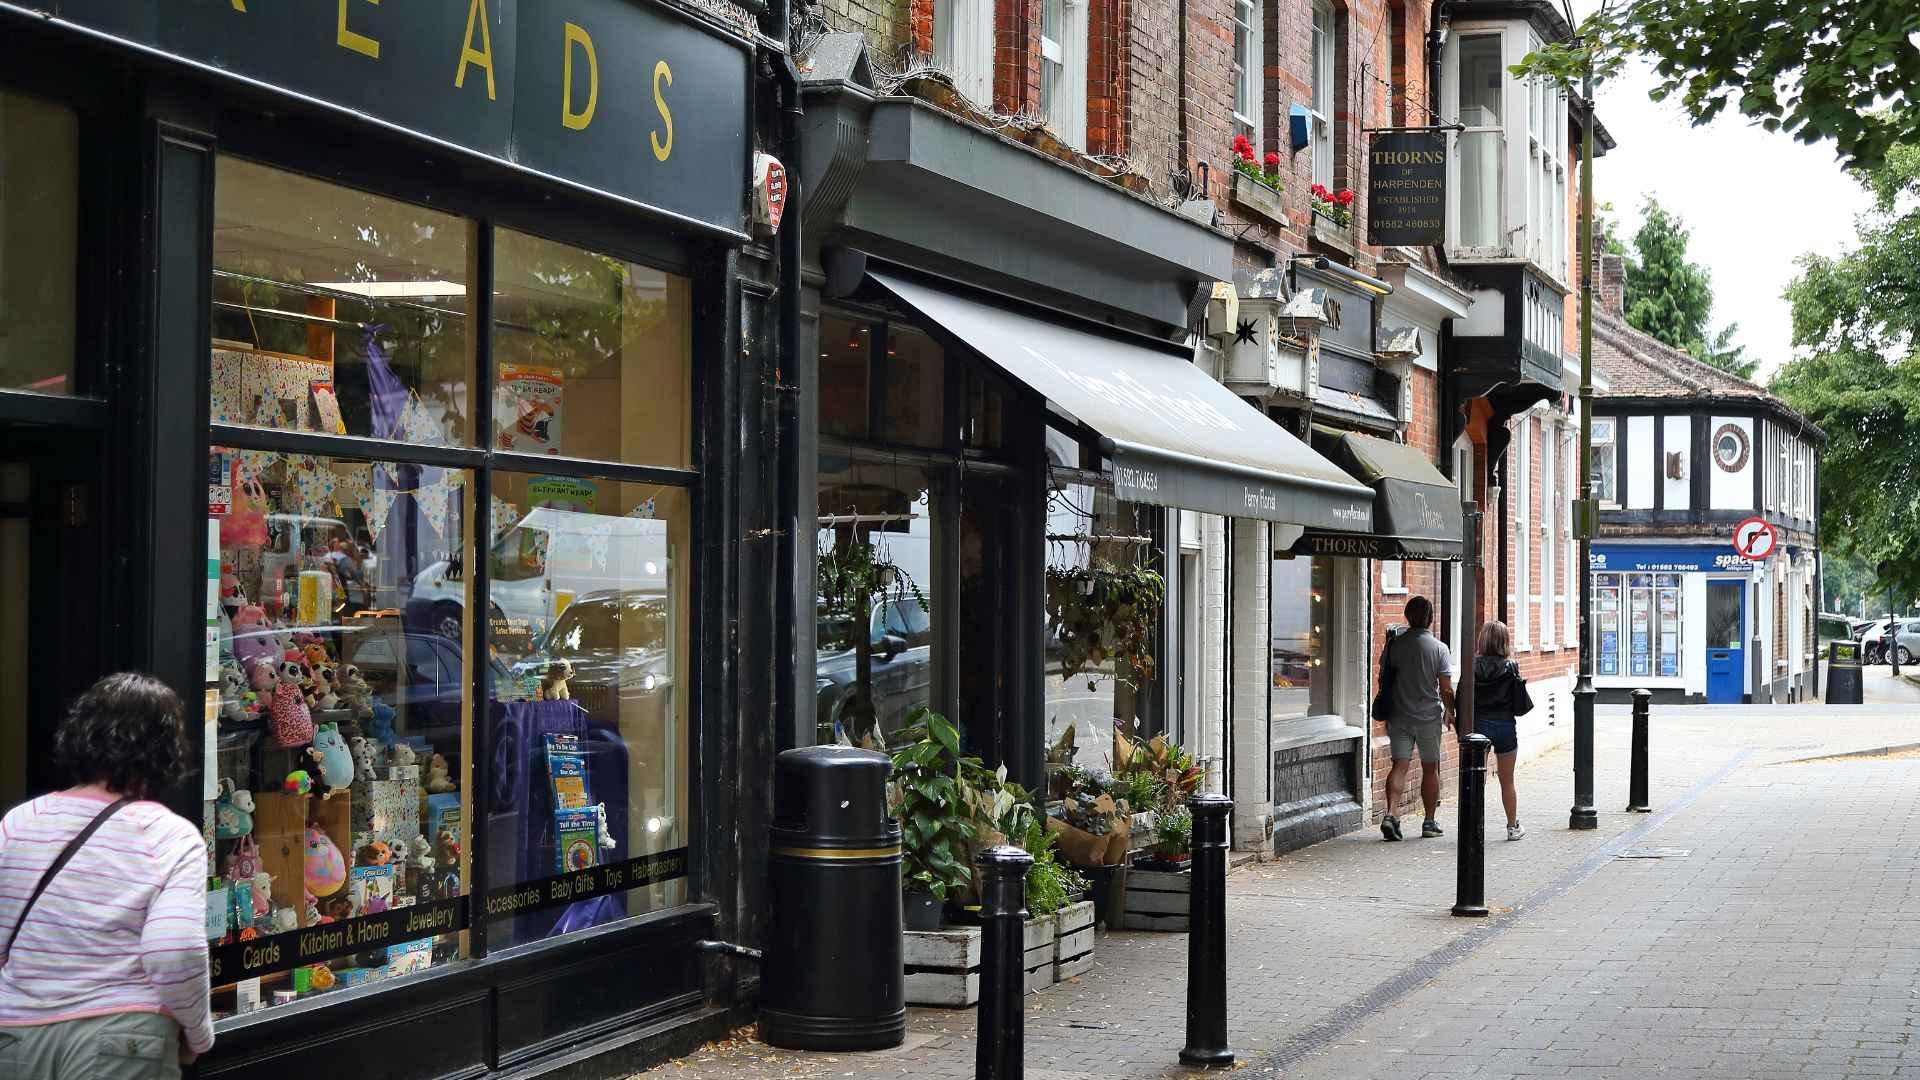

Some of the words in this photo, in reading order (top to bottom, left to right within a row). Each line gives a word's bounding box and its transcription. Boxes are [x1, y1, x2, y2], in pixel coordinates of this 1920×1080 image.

[225, 0, 674, 162] EADS
[1371, 151, 1444, 165] THORNS
[1401, 168, 1414, 176] OF
[1373, 179, 1442, 189] HARPENDEN
[1377, 195, 1440, 205] ESTABLISHED
[1312, 536, 1378, 554] THORNS
[551, 880, 573, 900] Baby
[574, 875, 595, 896] Gifts
[605, 868, 622, 888] Toys
[631, 854, 685, 881] Haberdashery
[242, 942, 280, 970] Cards
[300, 930, 343, 956] Kitchen
[346, 927, 354, 945] &
[357, 921, 390, 943] Home
[406, 906, 455, 932] Jewellery
